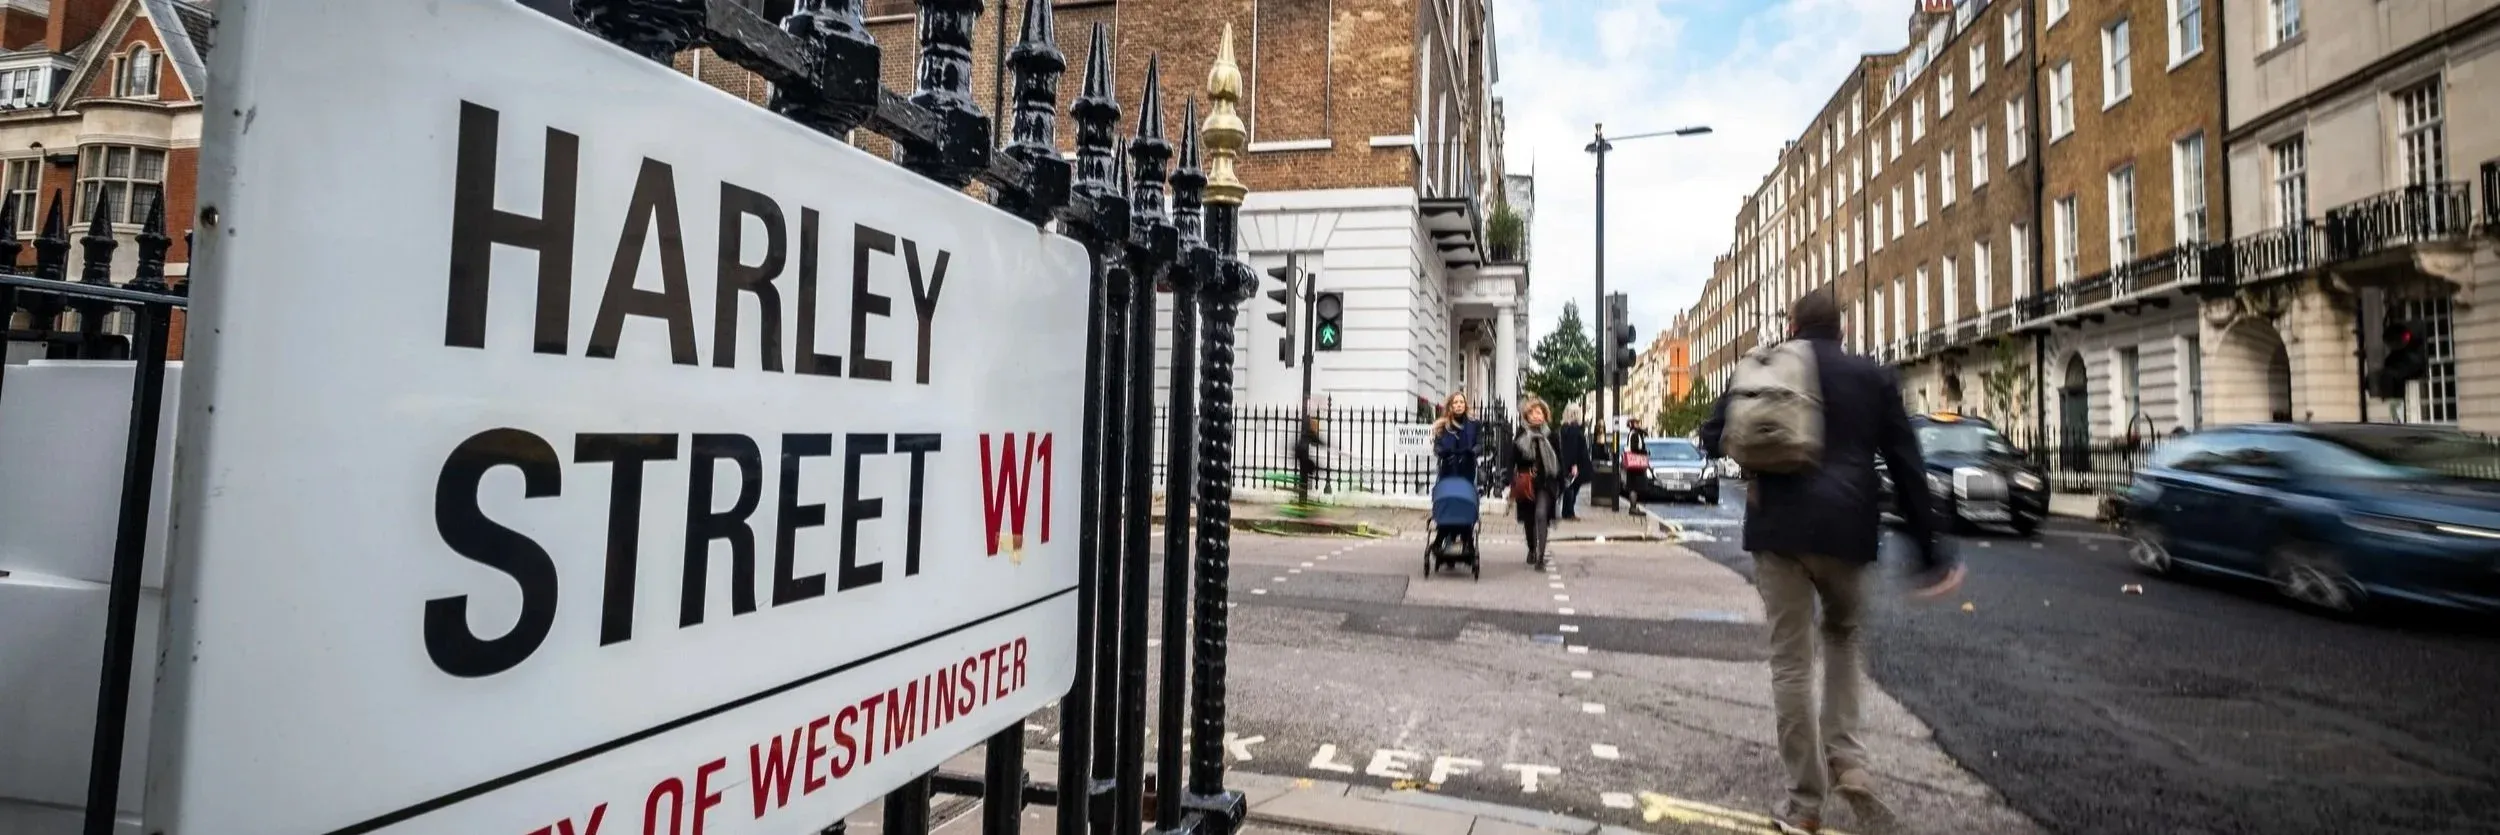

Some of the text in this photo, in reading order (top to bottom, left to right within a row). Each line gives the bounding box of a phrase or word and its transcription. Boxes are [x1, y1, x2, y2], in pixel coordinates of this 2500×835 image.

[445, 99, 951, 385] HARLEY
[1399, 427, 1431, 437] WEYMOU
[1399, 437, 1424, 446] STREET
[423, 427, 1054, 679] STREET W1
[643, 636, 1029, 835] OF WESTMINSTER
[1309, 743, 1562, 793] LEFT
